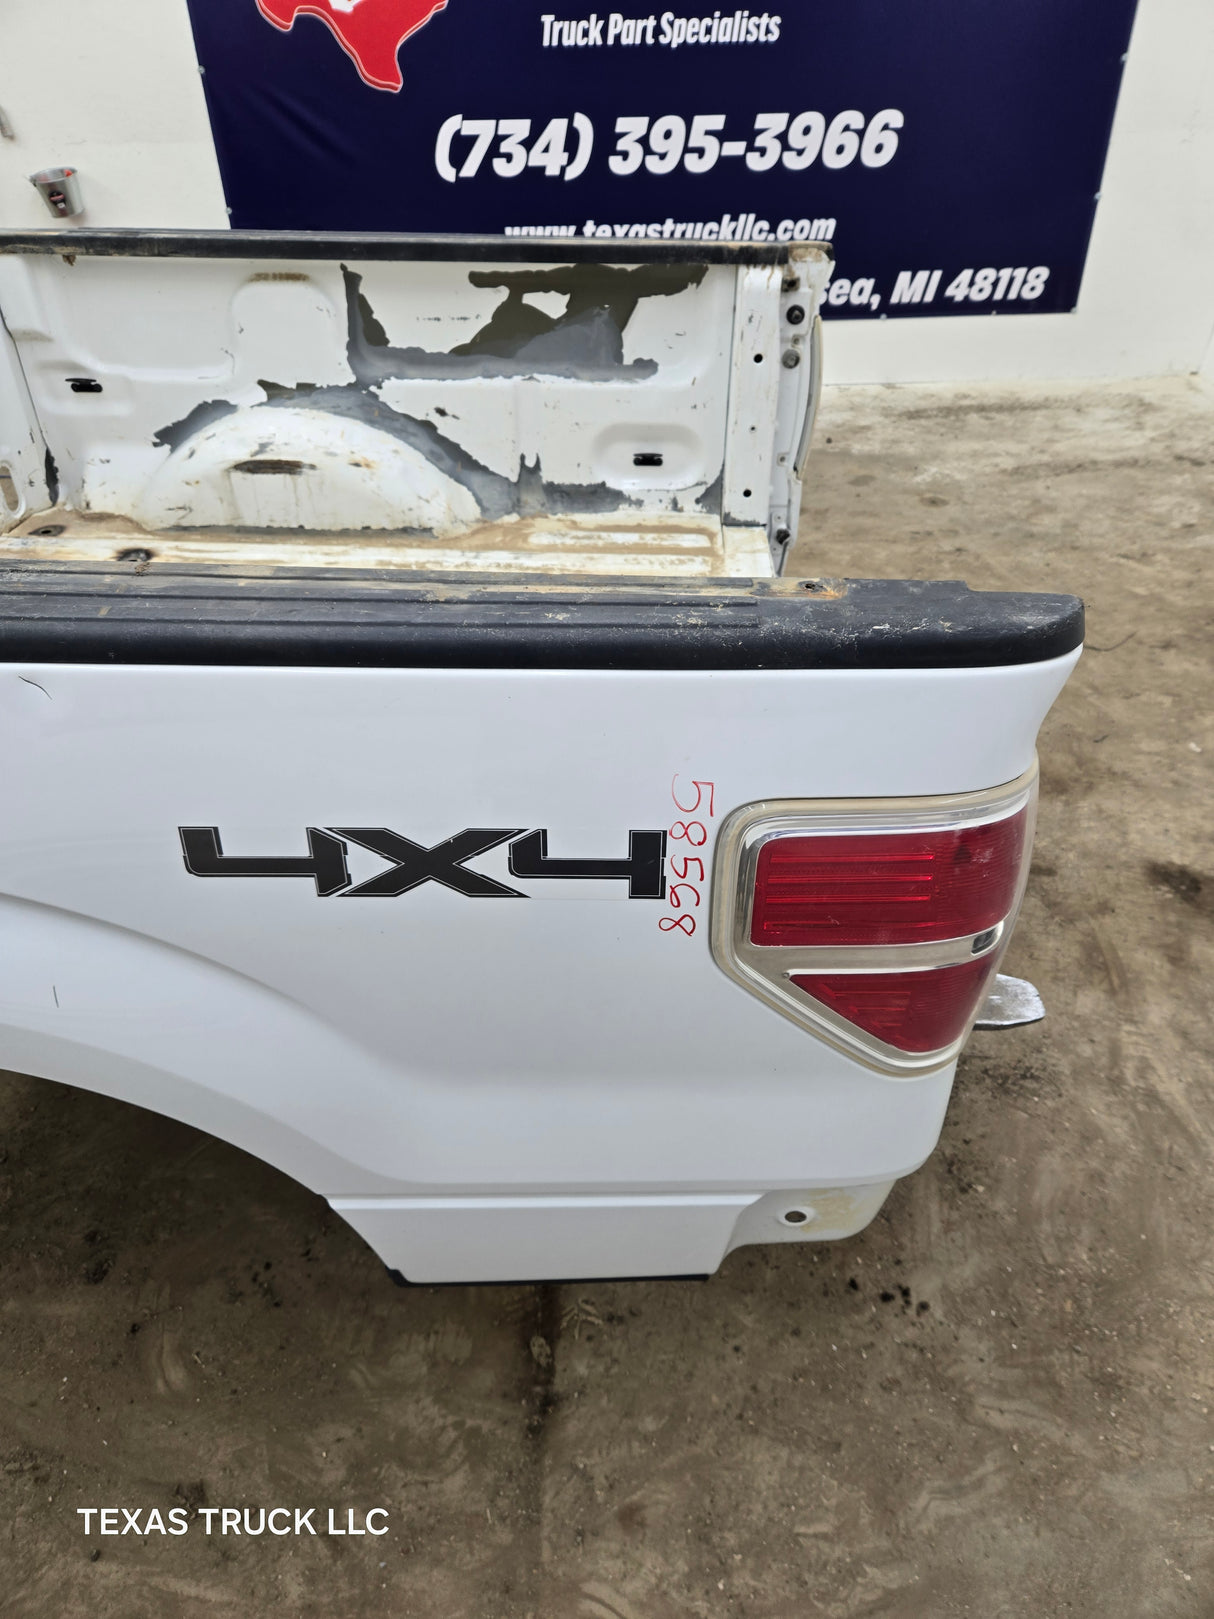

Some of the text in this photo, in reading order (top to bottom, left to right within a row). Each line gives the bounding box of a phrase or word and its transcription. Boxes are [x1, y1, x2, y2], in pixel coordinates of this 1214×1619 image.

[541, 10, 782, 48] Truck Part Specialists
[435, 109, 904, 182] (734) 395-3966
[504, 213, 837, 241] texastruckllc.com
[890, 270, 943, 305] MI
[944, 266, 1050, 302] 48118
[658, 773, 714, 937] 58568
